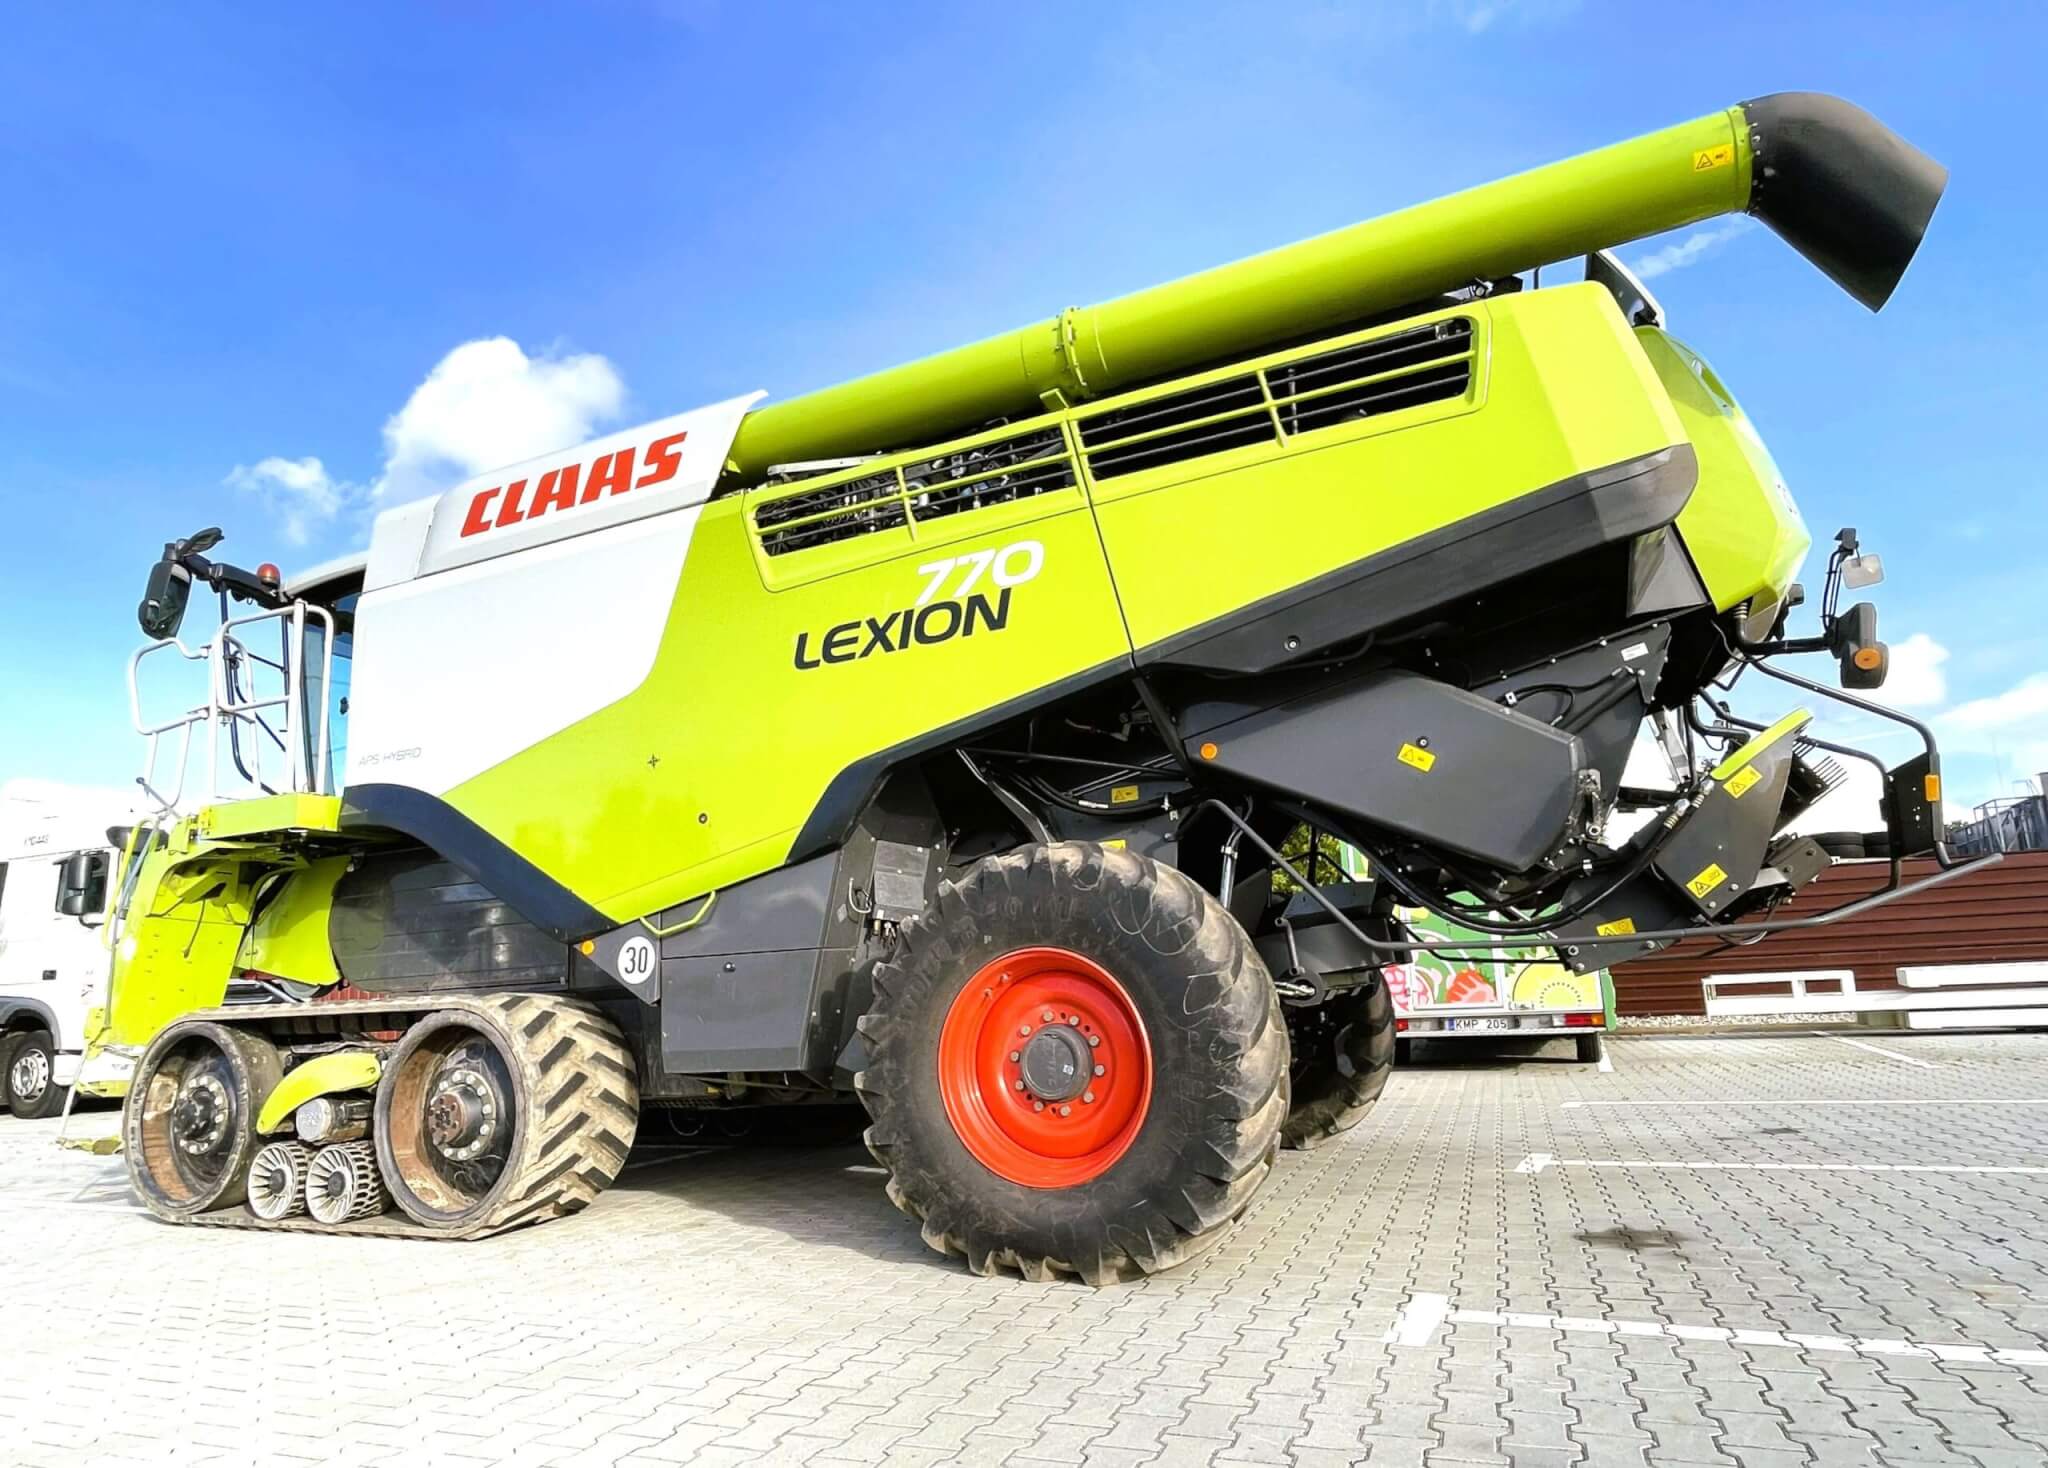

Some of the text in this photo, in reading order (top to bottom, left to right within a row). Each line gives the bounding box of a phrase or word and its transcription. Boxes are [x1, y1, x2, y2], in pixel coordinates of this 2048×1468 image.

[460, 431, 688, 538] CLAAS
[915, 540, 1045, 606] 770
[794, 587, 1012, 670] LEXION
[624, 946, 648, 974] 30
[1456, 1019, 1507, 1029] KMP 205
